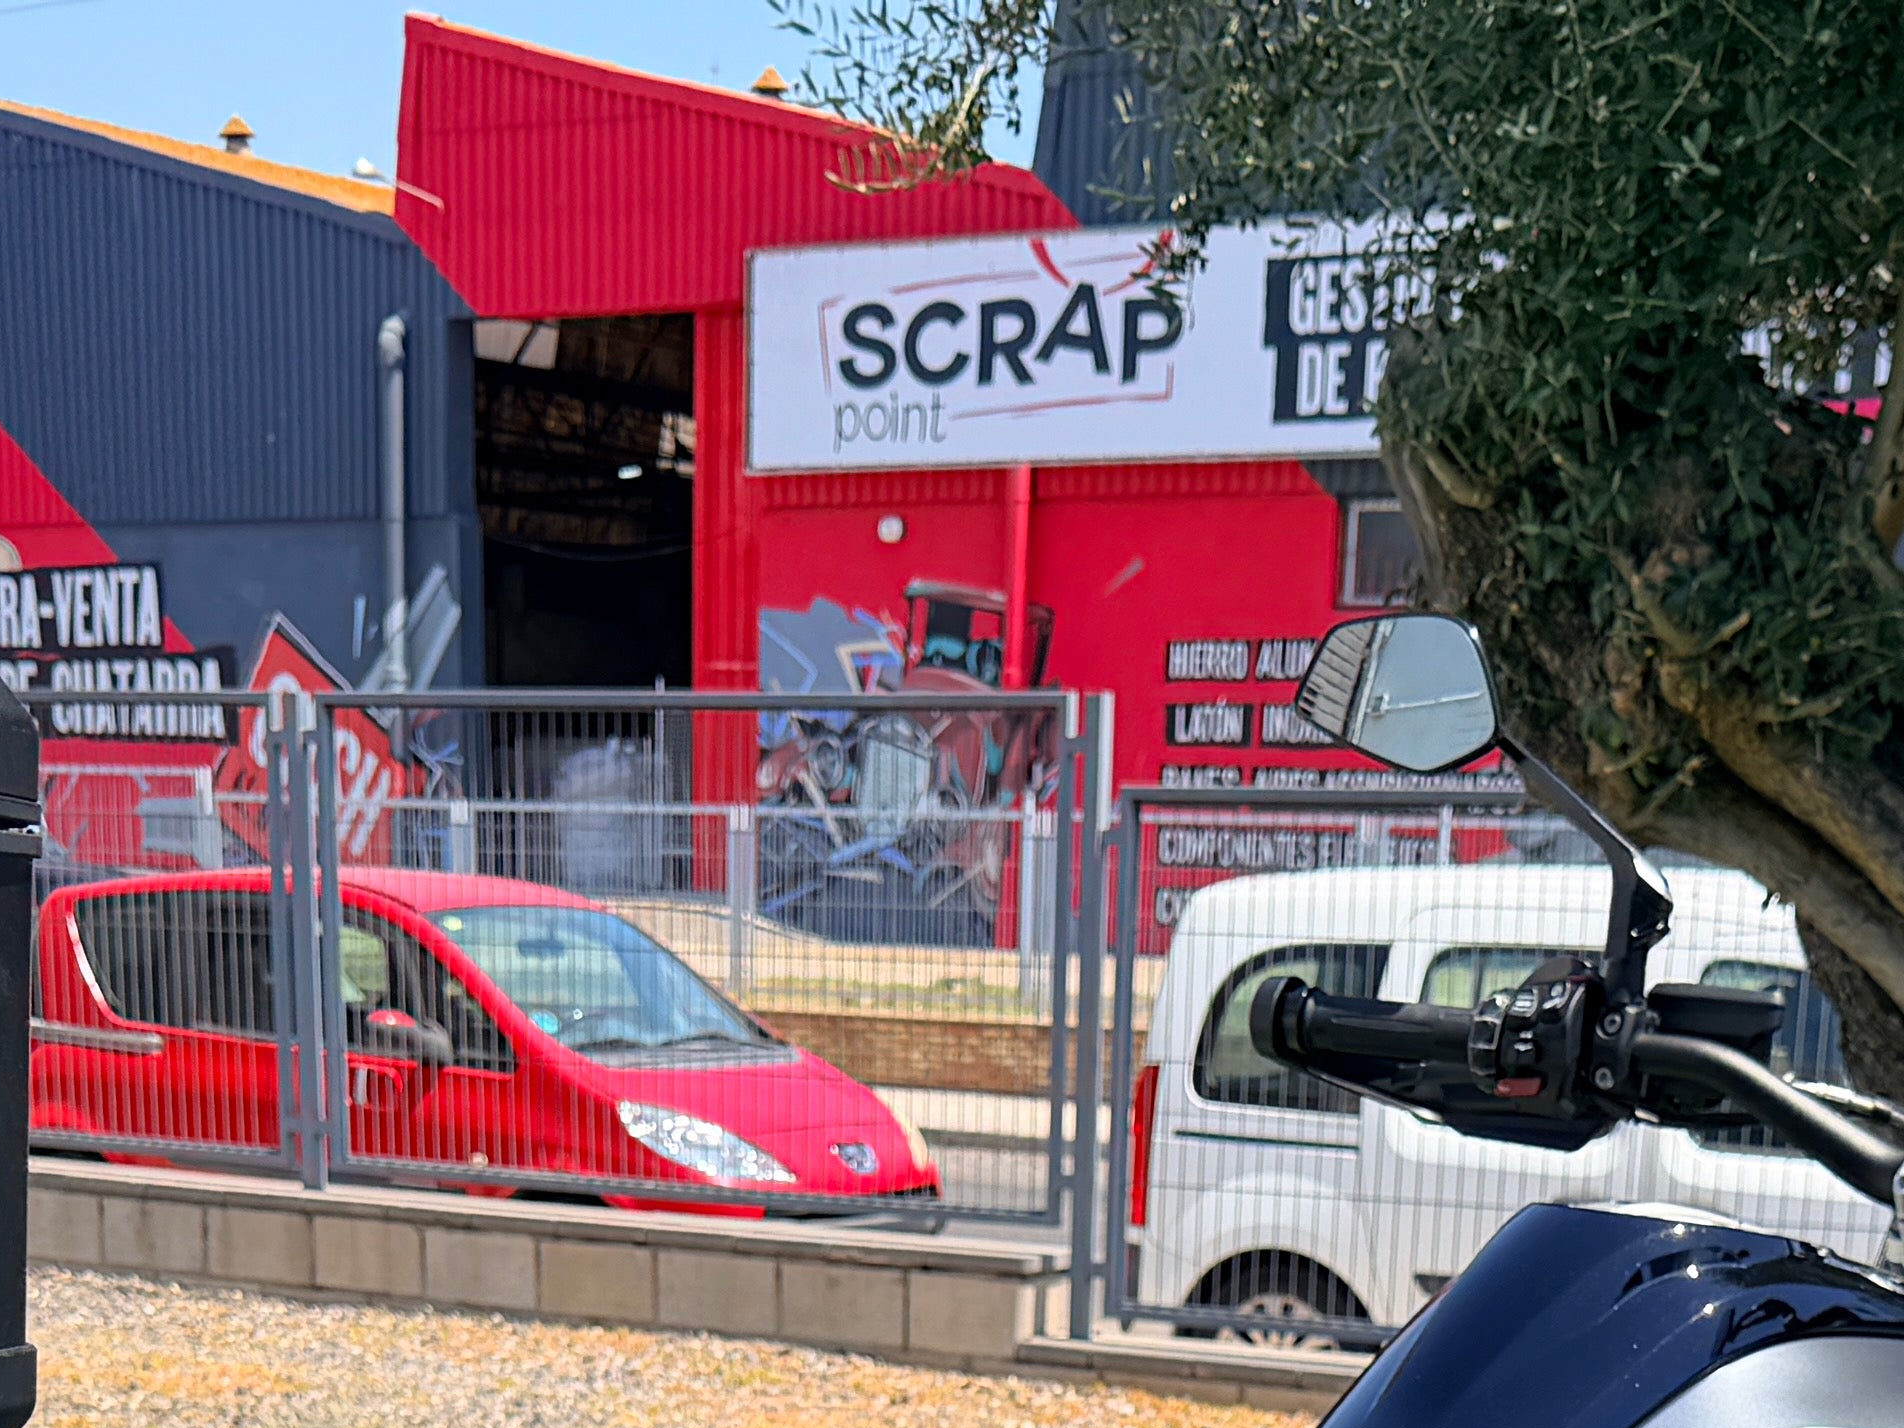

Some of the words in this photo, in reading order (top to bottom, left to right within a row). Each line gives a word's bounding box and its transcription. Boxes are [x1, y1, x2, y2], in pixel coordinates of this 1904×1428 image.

[838, 284, 1183, 389] SCRAP
[1296, 339, 1352, 417] DE
[833, 394, 947, 453] point
[1167, 640, 1249, 681] HIERRO
